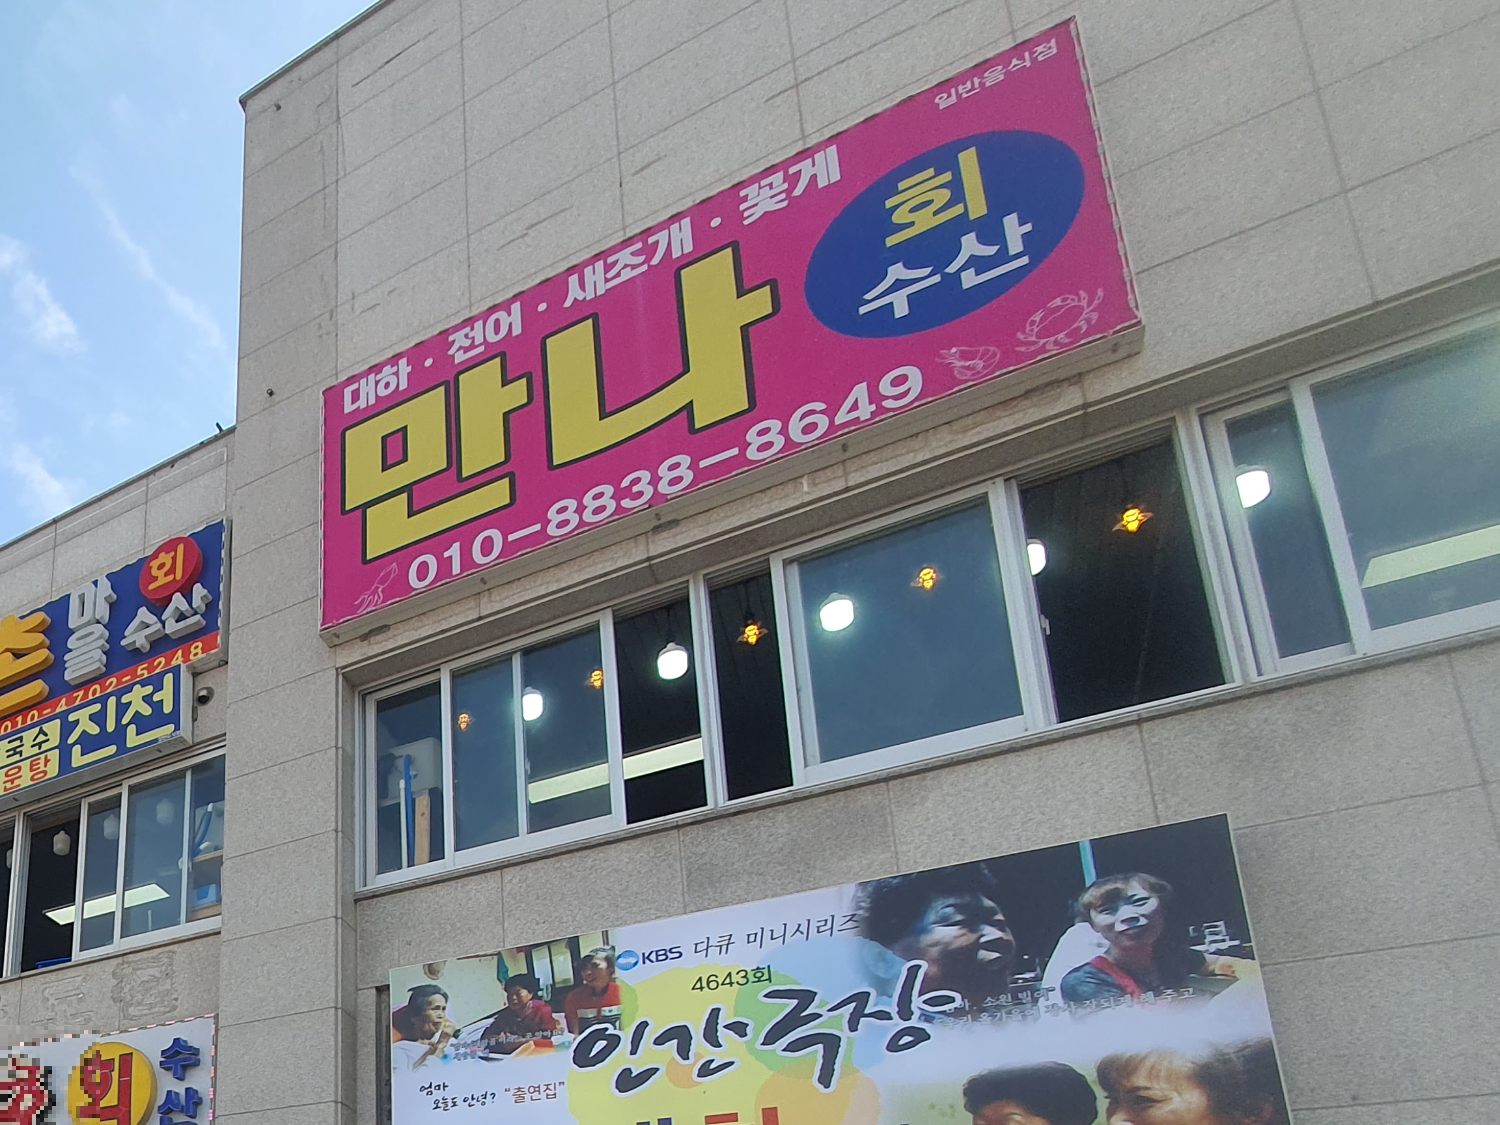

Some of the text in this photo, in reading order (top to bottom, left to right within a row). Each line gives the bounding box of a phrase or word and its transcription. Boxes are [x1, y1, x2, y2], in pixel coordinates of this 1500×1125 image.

[933, 38, 1058, 111] 일반음식점
[884, 145, 988, 250] 회
[342, 145, 842, 414] 대하 전어 새조개 꽃게
[859, 213, 1034, 320] 수산
[342, 240, 780, 564] 만나
[407, 364, 924, 591] 010-8838-8649
[148, 544, 184, 591] 회
[64, 576, 117, 686] 마을
[120, 583, 213, 653] 수산
[0, 642, 203, 734] 010-4702-5248
[68, 672, 174, 768] 진천
[641, 912, 861, 966] KBS 다큐 미니시리즈
[690, 964, 773, 993] 4643회
[573, 963, 960, 1093] 인간극장
[419, 1081, 449, 1096] 엄마
[432, 1096, 458, 1112] 오늘도
[463, 1091, 497, 1108] 안녕?
